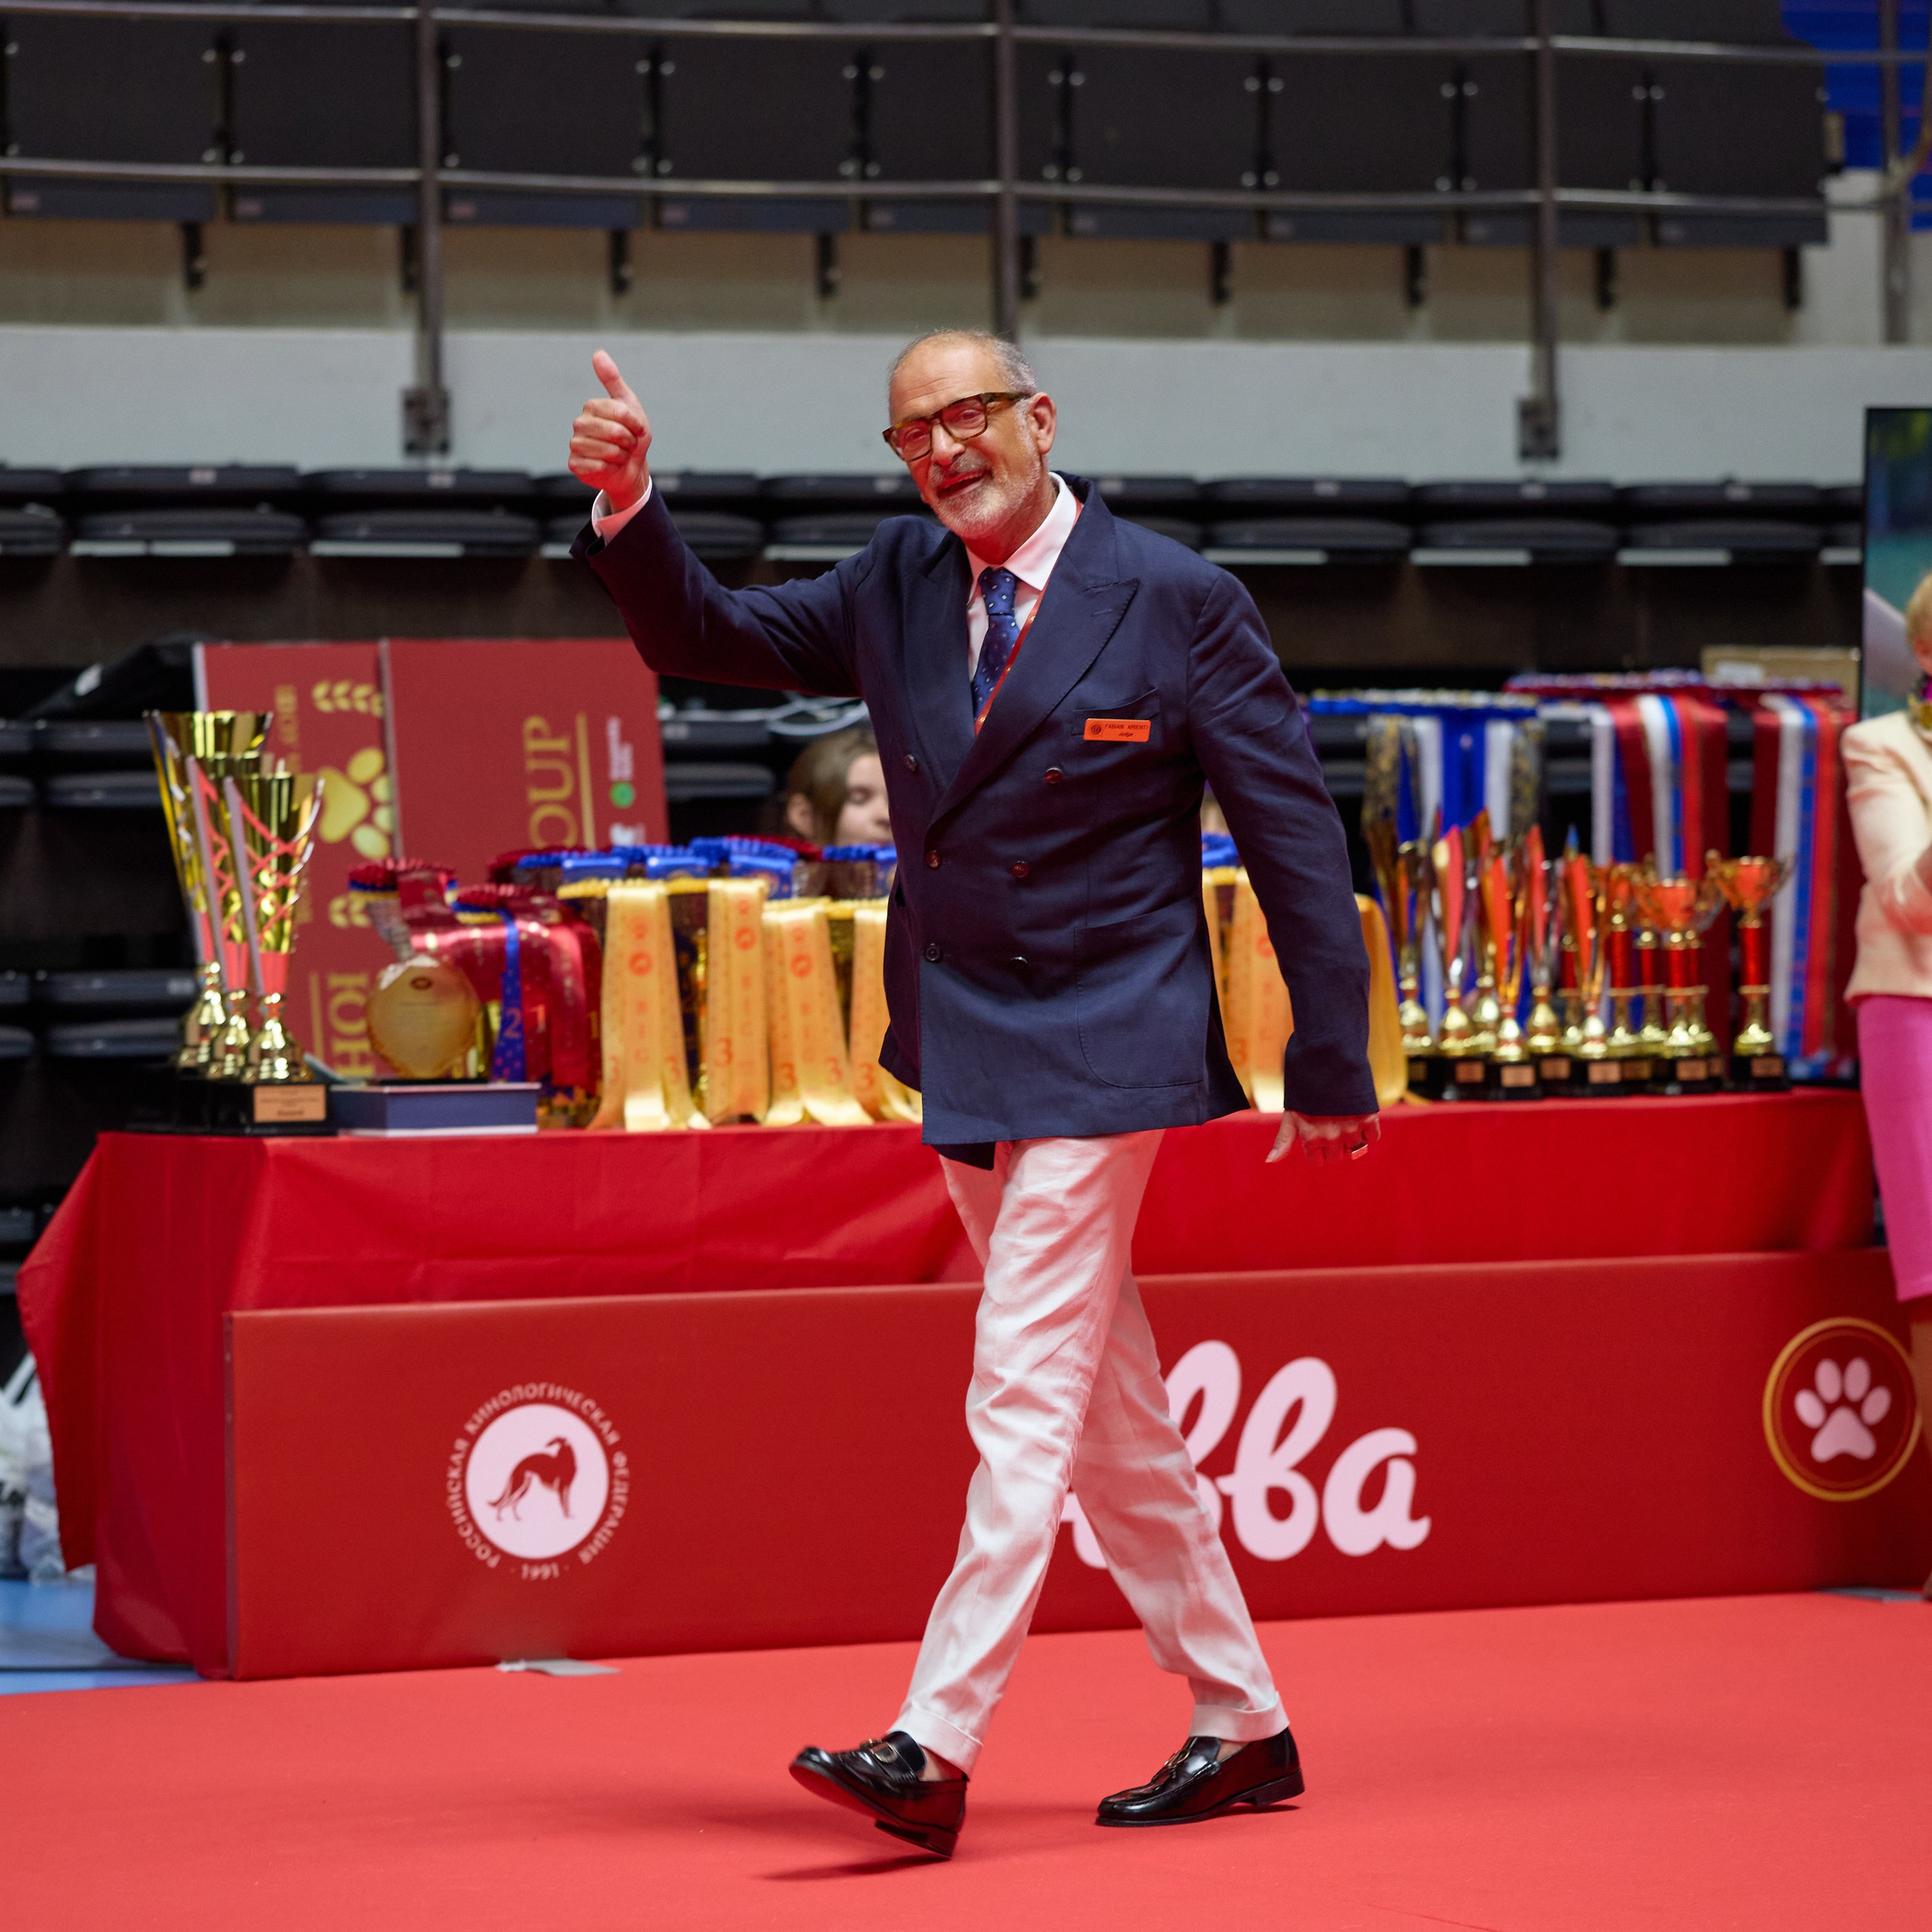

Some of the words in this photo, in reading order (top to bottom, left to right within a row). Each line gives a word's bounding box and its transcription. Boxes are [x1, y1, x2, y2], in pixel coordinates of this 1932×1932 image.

[504, 1008, 522, 1038] 2
[464, 1382, 620, 1446] КИНОЛОГИЧЕСКАЯ
[446, 1438, 501, 1568] РОССИЙСКАЯ
[578, 1451, 630, 1564] ФЕДЕРАЦИЯ
